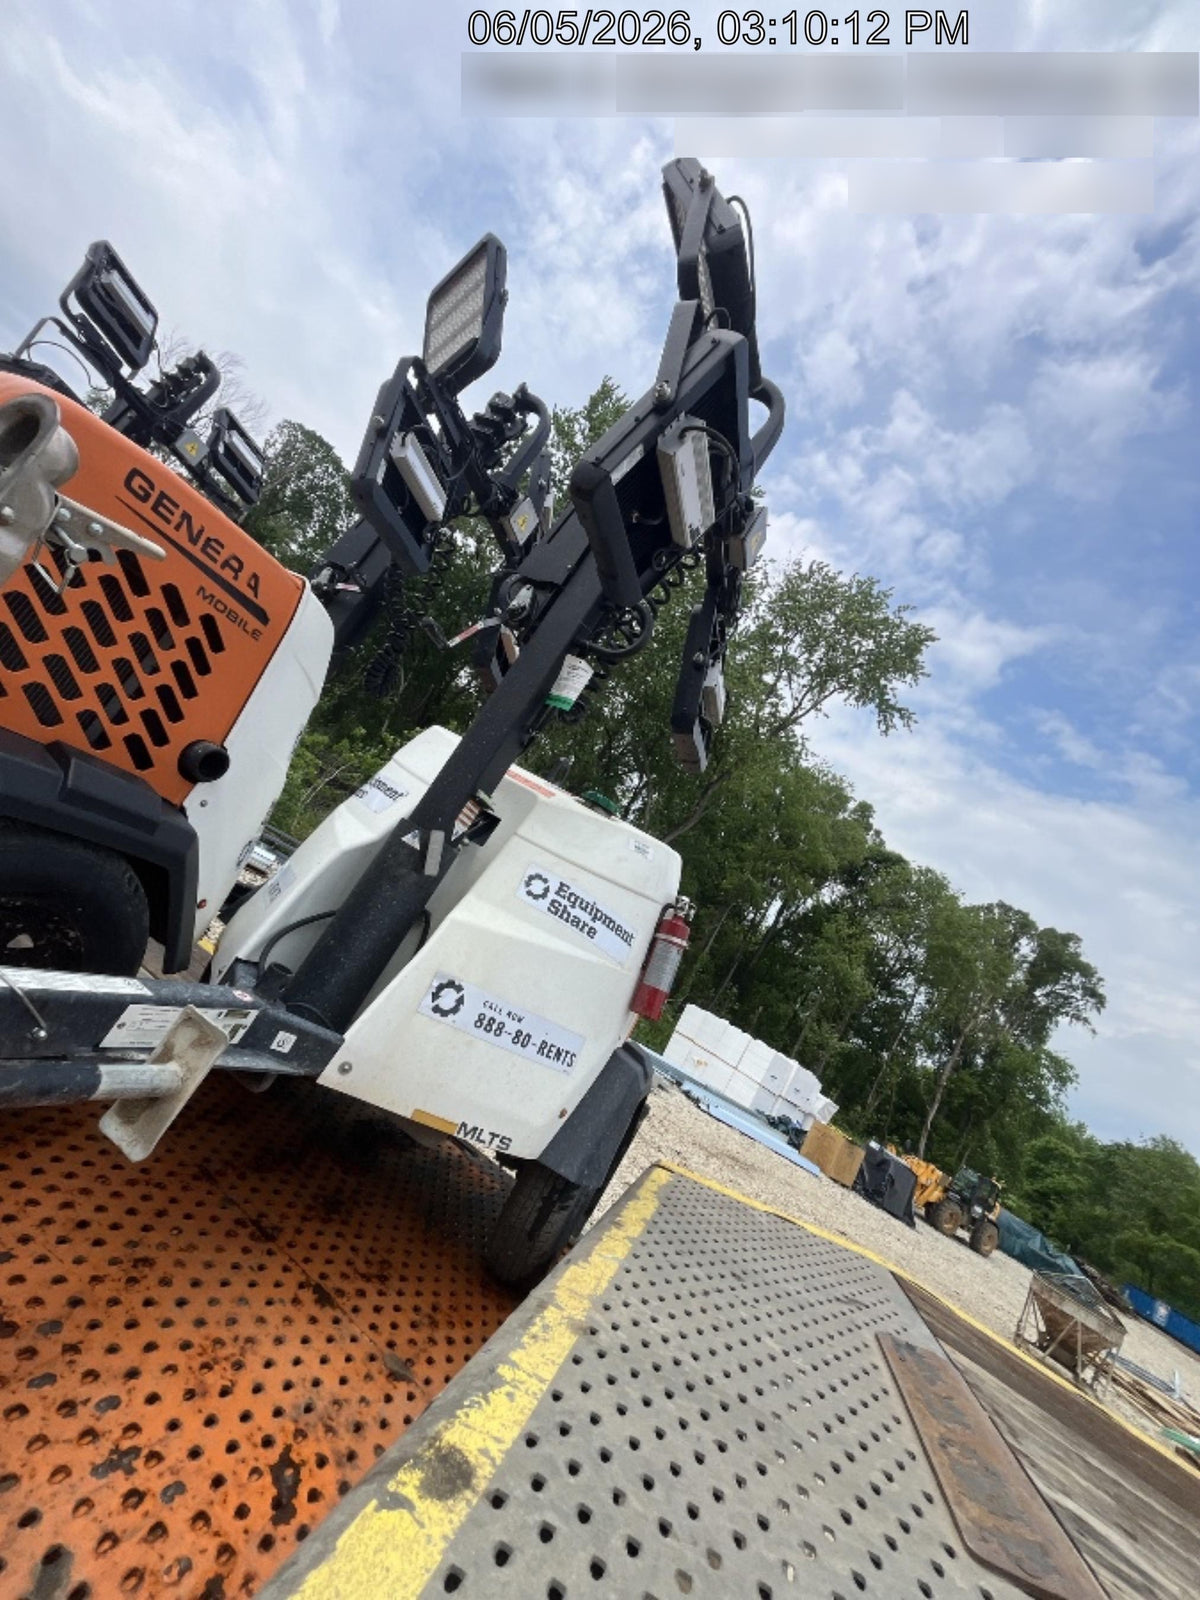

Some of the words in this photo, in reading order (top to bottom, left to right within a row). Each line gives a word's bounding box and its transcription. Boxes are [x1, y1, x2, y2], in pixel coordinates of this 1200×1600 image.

[196, 586, 263, 642] MOBILE
[547, 898, 598, 940] Share
[554, 881, 635, 947] Equipment
[483, 1000, 502, 1016] CALL
[506, 1010, 525, 1024] NOW
[474, 1012, 577, 1068] 888-80-RENTS
[456, 1121, 513, 1151] MLTS
